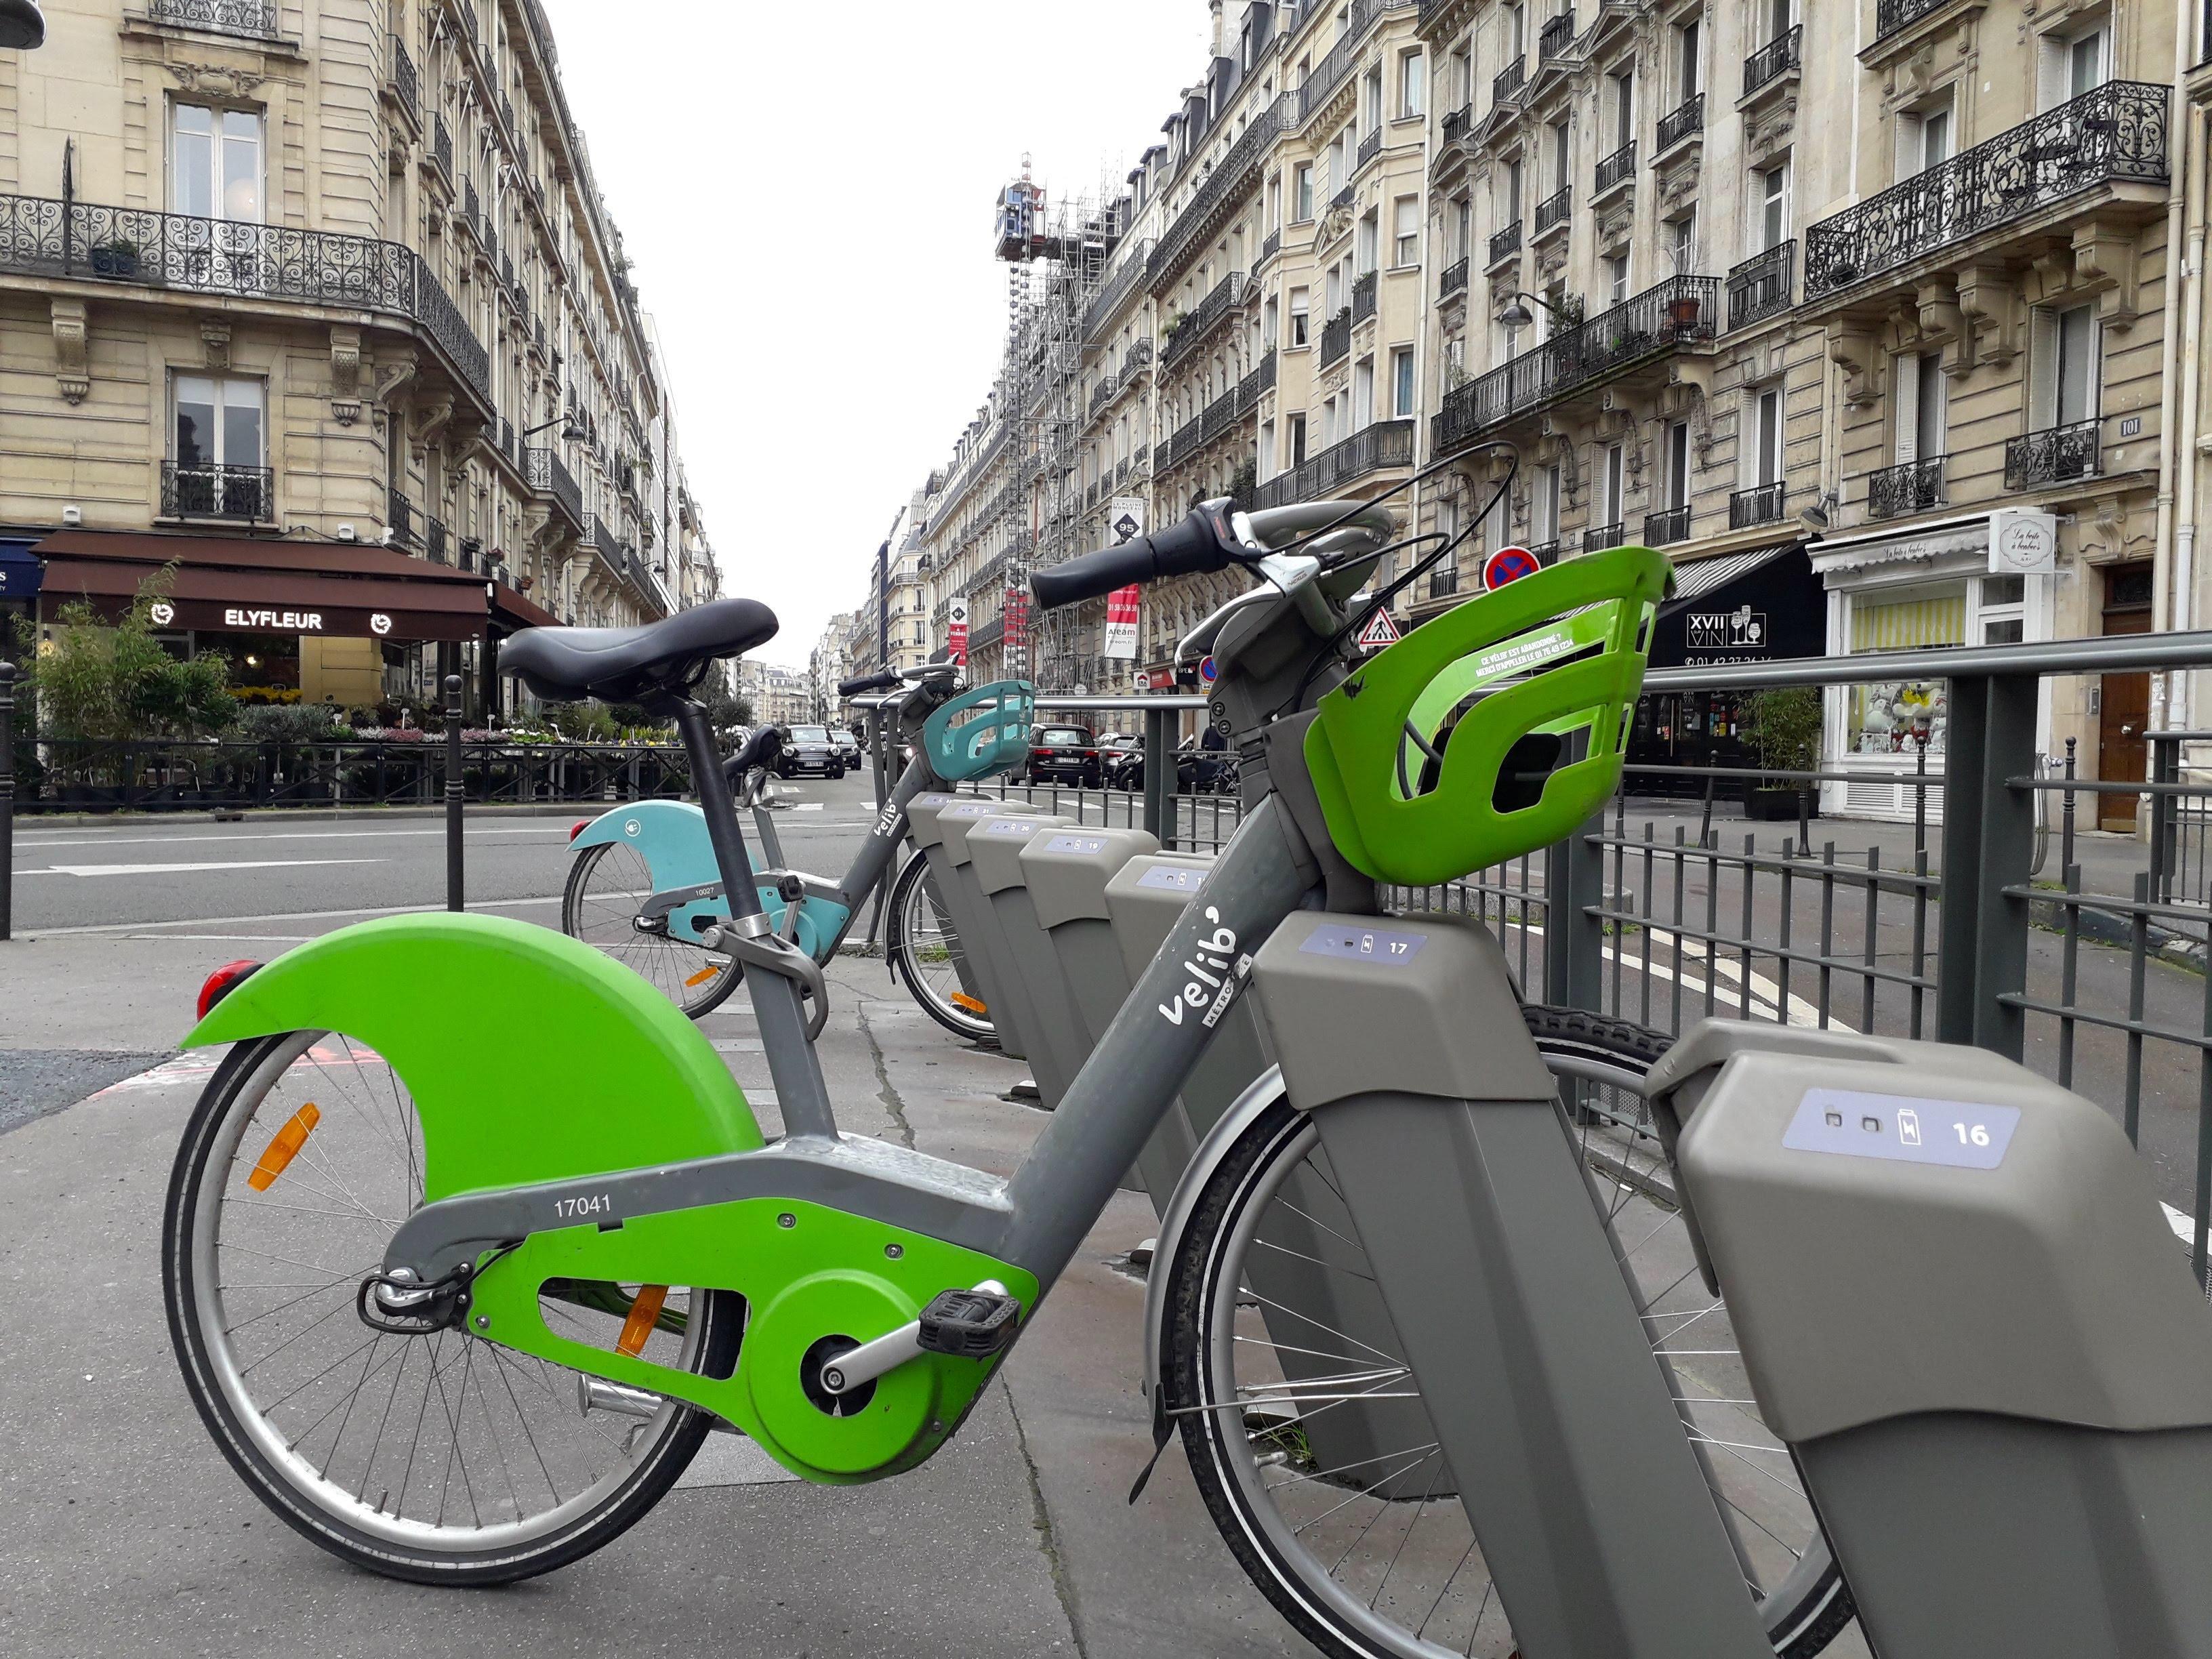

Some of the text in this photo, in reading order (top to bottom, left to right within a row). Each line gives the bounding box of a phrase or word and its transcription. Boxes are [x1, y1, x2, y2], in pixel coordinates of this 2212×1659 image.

[2123, 419, 2138, 436] 101
[1120, 523, 1134, 533] 95
[225, 609, 323, 630] ELYFLEUR
[1690, 616, 1724, 630] XVII
[1690, 630, 1724, 646] VIN
[1509, 647, 1520, 658] EST
[1697, 657, 1708, 665] 01
[695, 887, 714, 897] 10027
[1389, 942, 1408, 954] 17
[1952, 1122, 1990, 1147] 16
[554, 1193, 610, 1218] 17041
